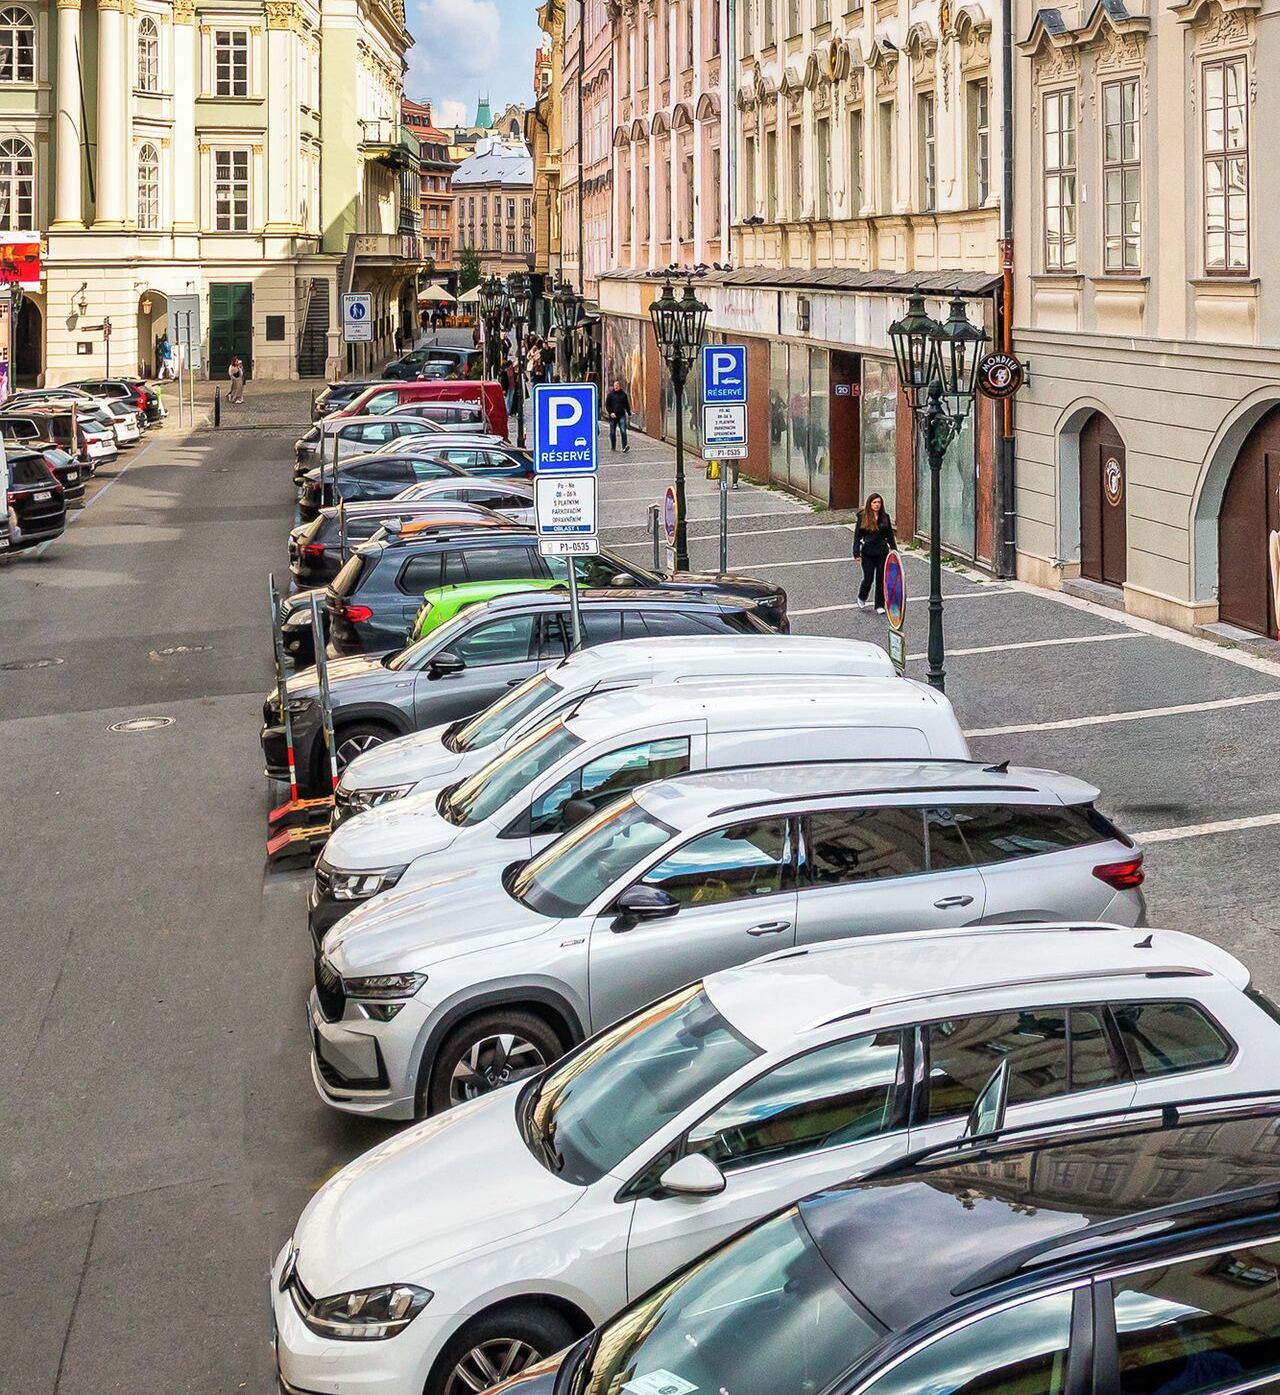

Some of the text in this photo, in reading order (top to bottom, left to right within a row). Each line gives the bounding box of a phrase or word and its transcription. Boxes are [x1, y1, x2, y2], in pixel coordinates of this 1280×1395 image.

[713, 354, 736, 385] P
[982, 355, 1018, 372] MONDIEU
[708, 386, 742, 396] RÉSERVÉ
[548, 396, 582, 446] P
[542, 448, 590, 462] RÉSERVÉ
[560, 542, 590, 551] P1-0535
